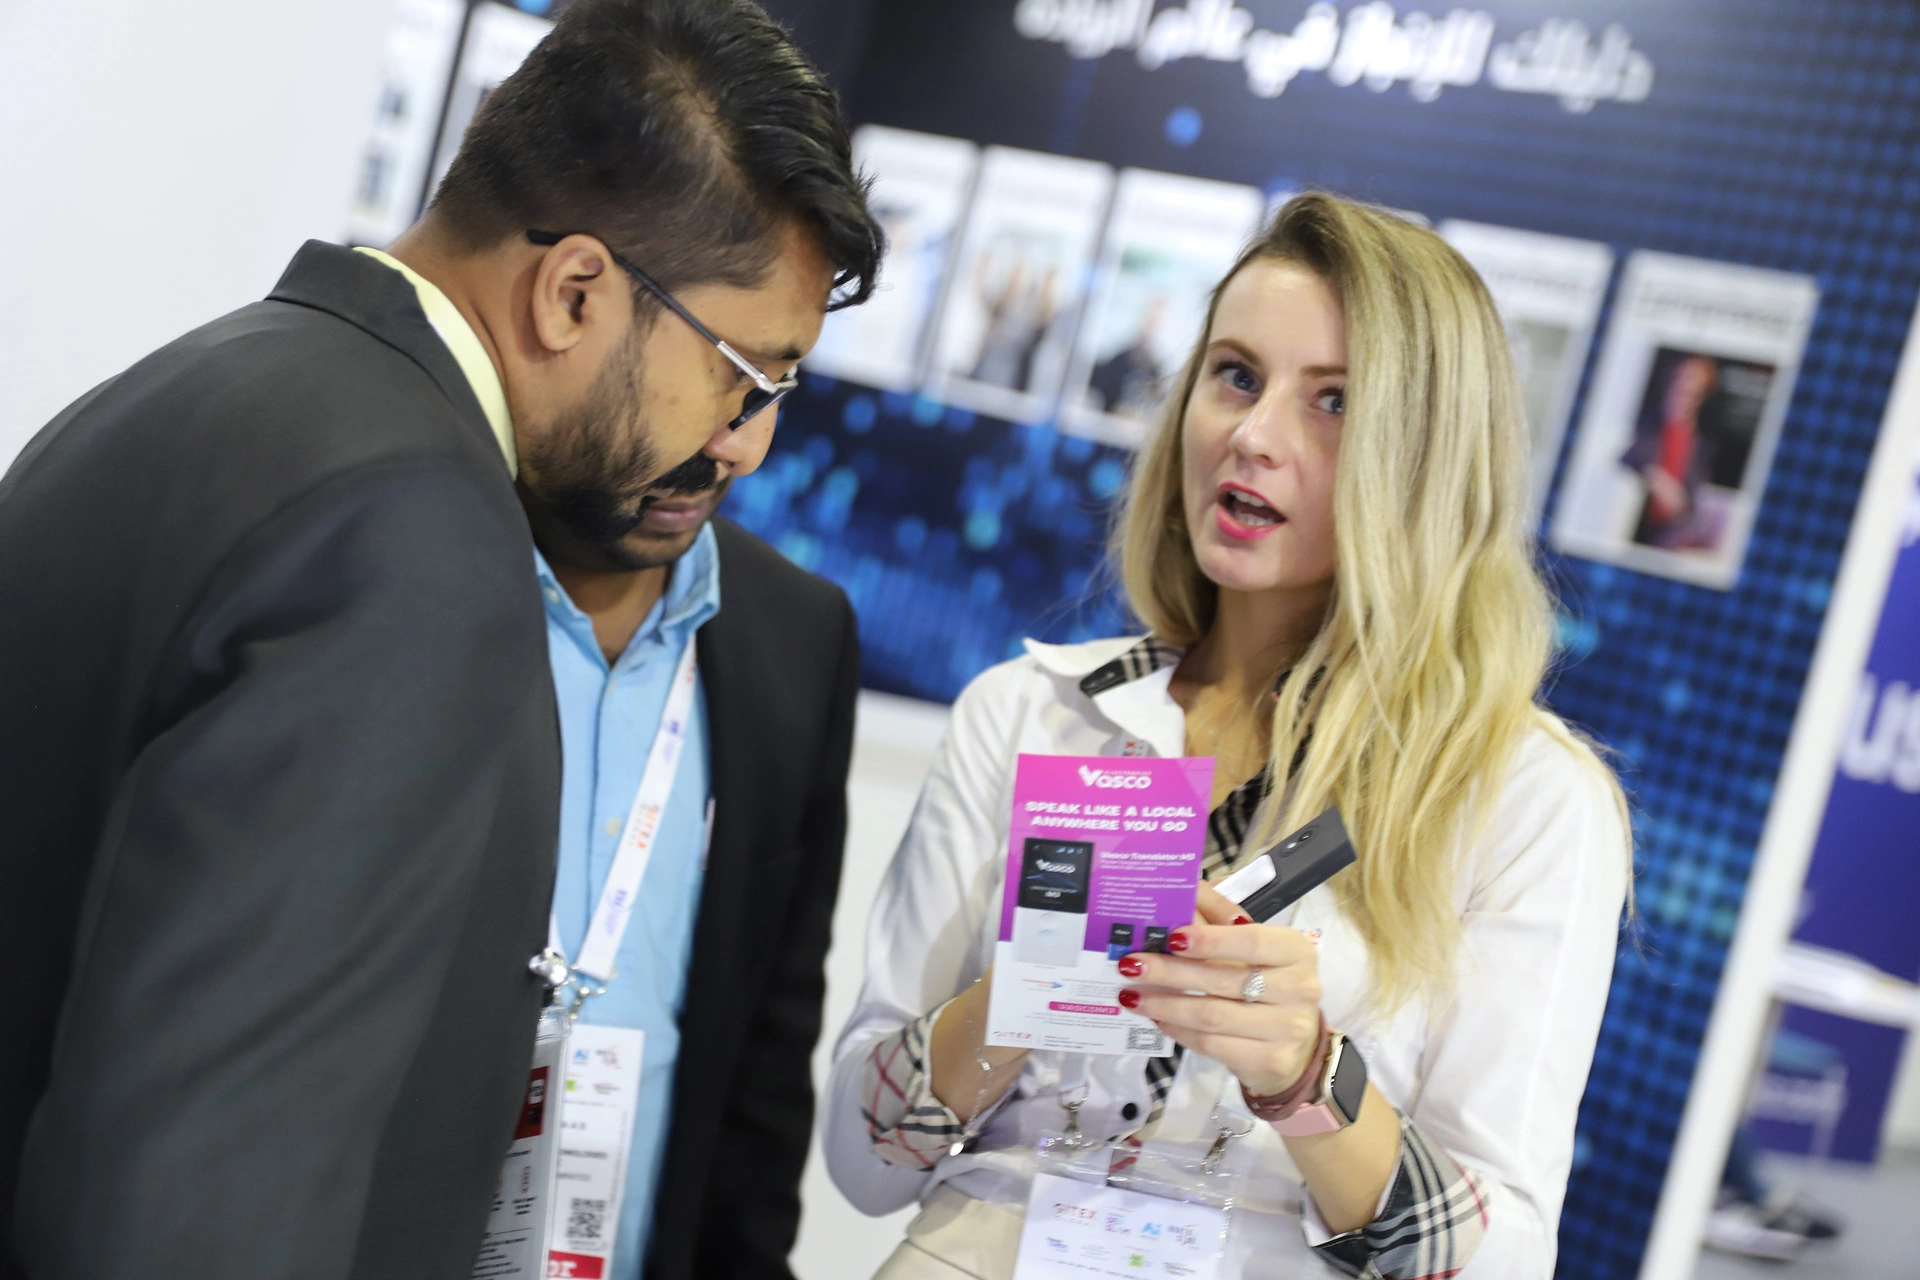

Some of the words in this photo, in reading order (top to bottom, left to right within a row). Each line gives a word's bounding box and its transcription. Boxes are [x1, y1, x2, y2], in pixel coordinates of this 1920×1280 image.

[1025, 801, 1081, 815] SPEAK
[1083, 804, 1121, 817] LIKE
[1124, 806, 1138, 817] A
[1142, 806, 1197, 818] LOCAL
[1030, 815, 1120, 831] ANYWHERE
[1123, 820, 1158, 832] YOU
[1161, 821, 1187, 832] GO
